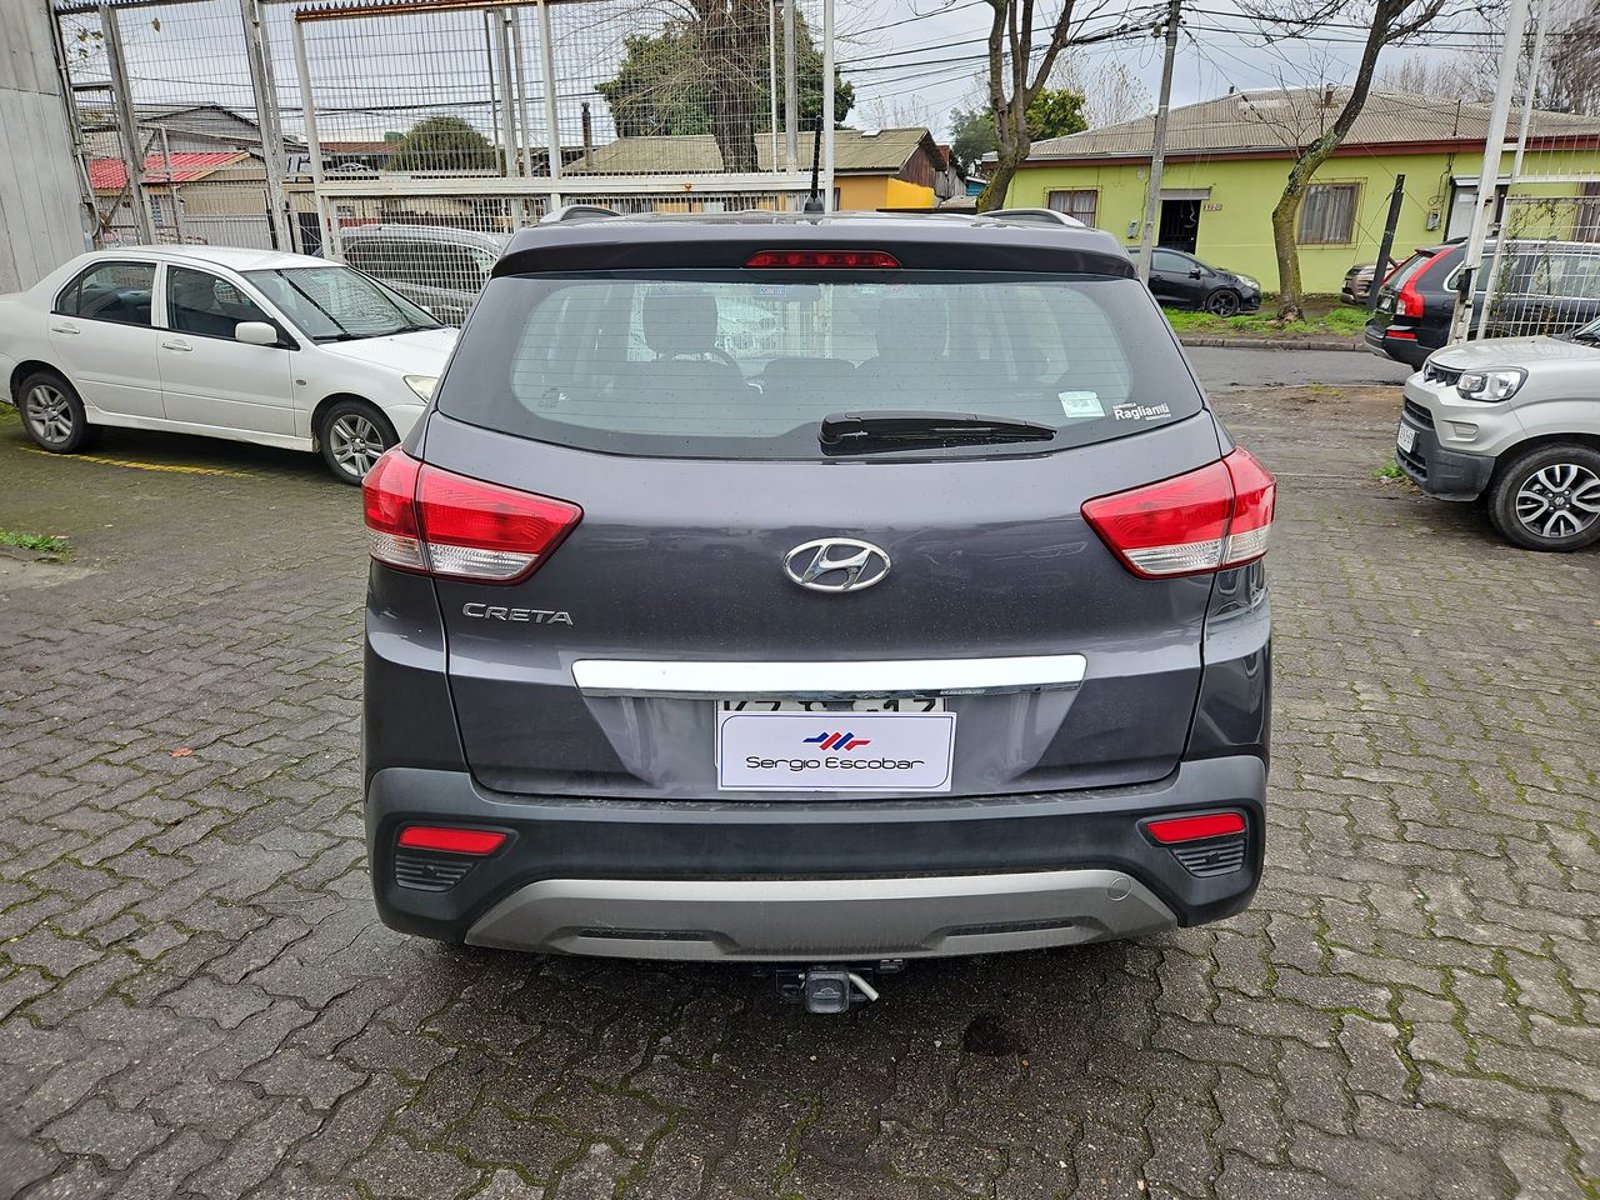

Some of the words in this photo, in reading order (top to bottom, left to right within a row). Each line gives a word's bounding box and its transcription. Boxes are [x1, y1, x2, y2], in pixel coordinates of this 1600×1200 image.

[462, 602, 573, 625] CRETA
[746, 756, 820, 771] Sergio
[825, 757, 925, 770] Escobar
